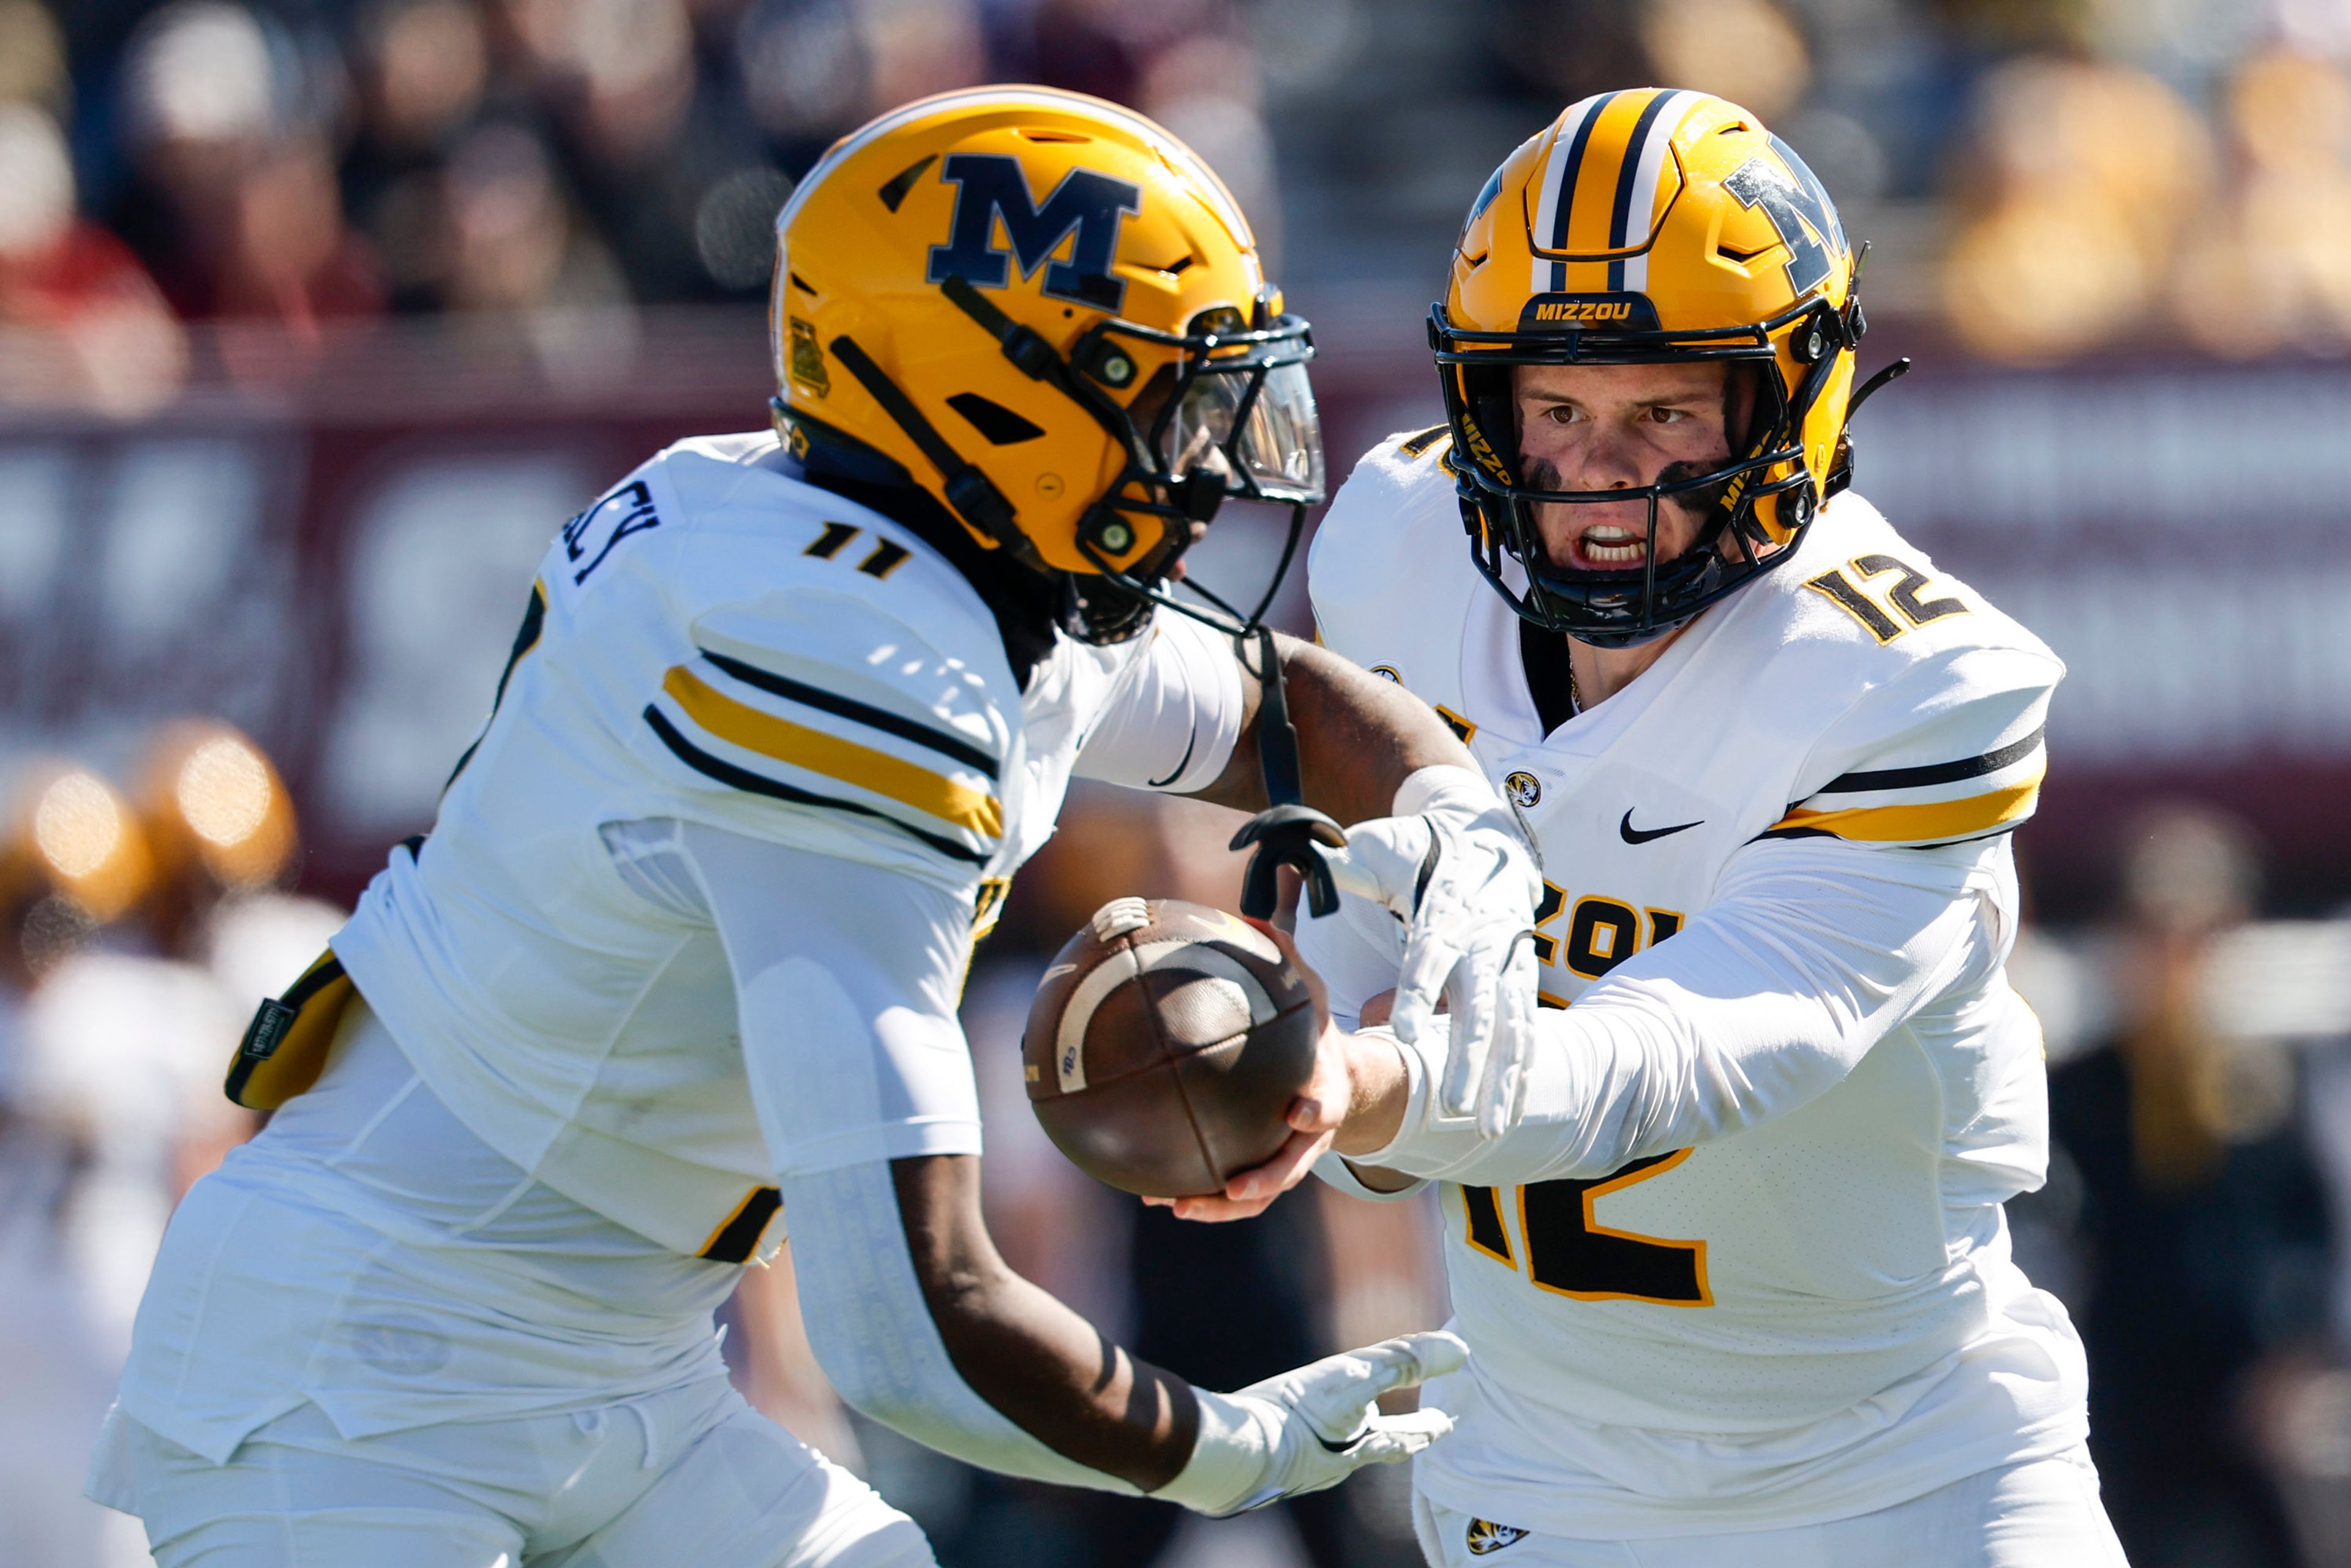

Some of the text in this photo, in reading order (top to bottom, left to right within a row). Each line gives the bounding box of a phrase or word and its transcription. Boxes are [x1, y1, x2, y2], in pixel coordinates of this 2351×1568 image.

[926, 152, 1142, 316] M
[1720, 131, 1850, 298] M
[1535, 302, 1632, 320] MIZZOU
[801, 520, 914, 581] 11
[1801, 553, 1971, 647] 12
